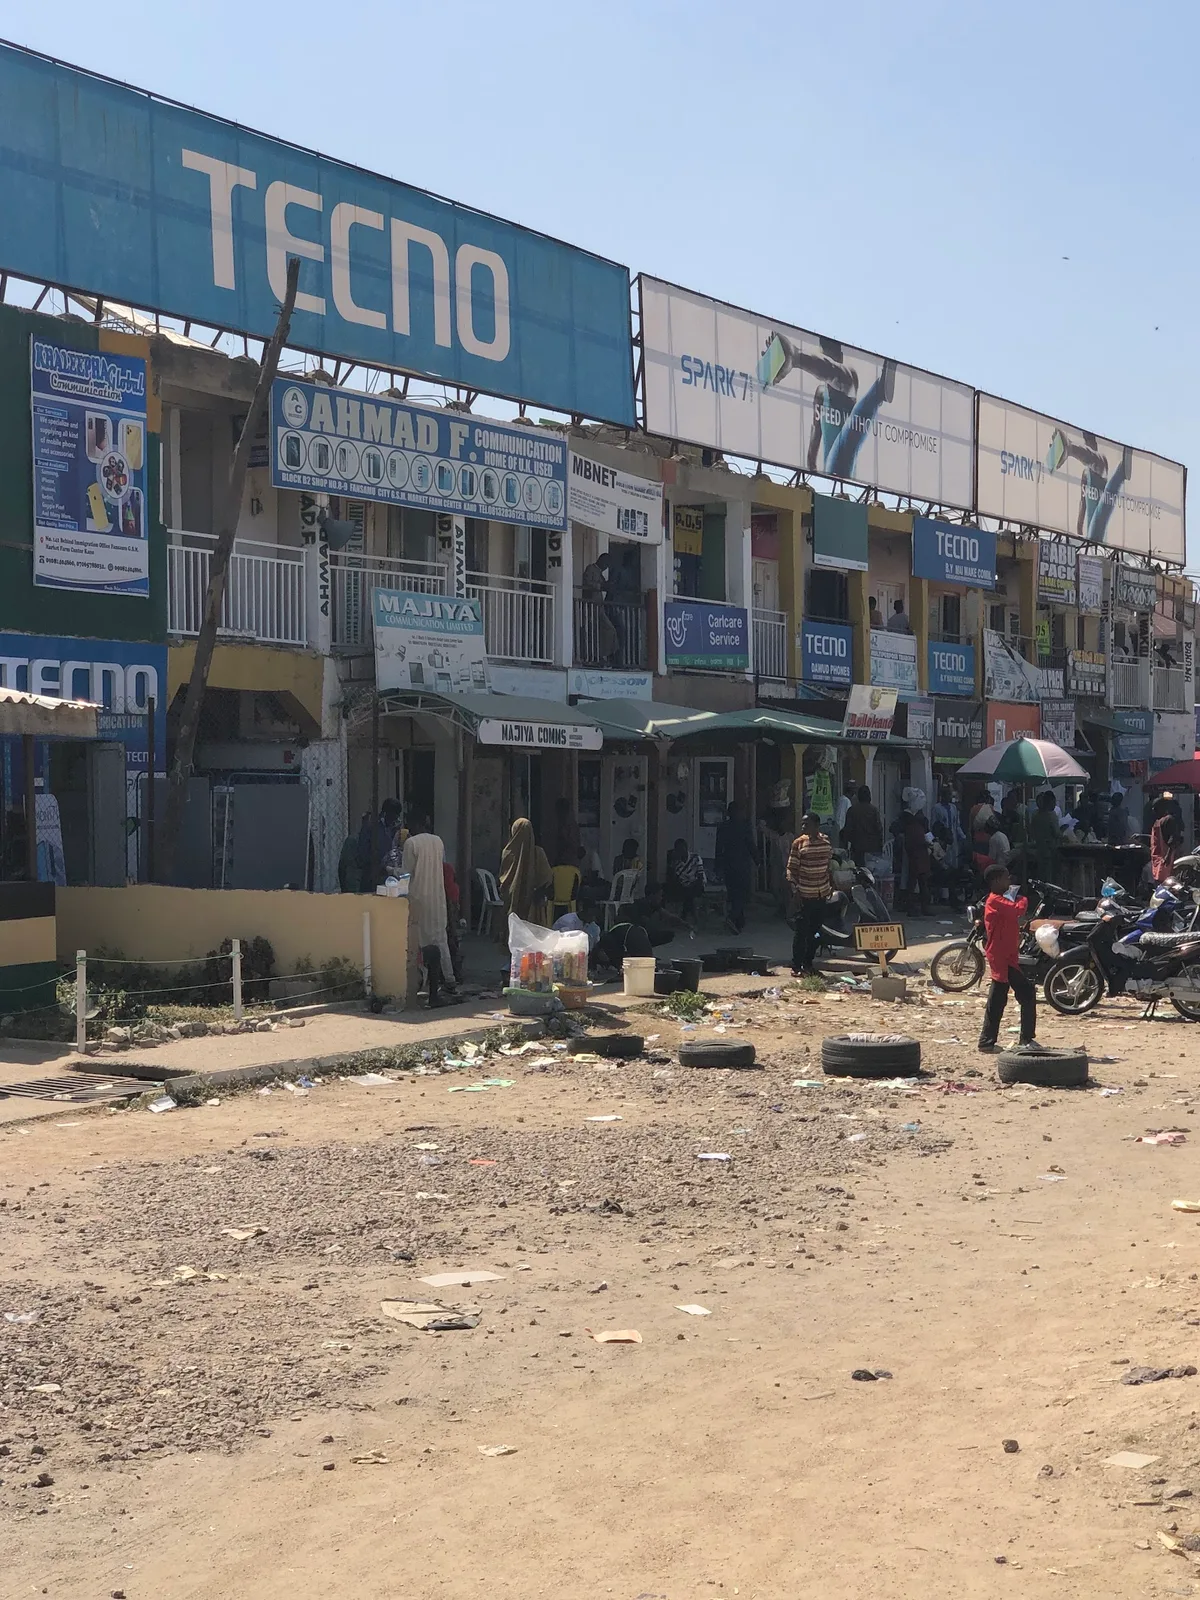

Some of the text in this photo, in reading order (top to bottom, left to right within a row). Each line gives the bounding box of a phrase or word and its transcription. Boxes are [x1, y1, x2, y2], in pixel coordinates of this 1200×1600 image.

[182, 149, 510, 362] TECNO
[50, 373, 122, 403] Communication
[108, 364, 144, 396] Global
[681, 355, 736, 398] SPARK
[740, 372, 748, 401] 7
[40, 428, 62, 437] supplying
[310, 392, 477, 462] AHMAD F.
[815, 404, 937, 453] SPEED WITHOUT COMPROMISE
[46, 438, 61, 446] mobile
[62, 440, 76, 448] phone
[475, 428, 562, 464] COMMUNICATION
[484, 450, 507, 469] HOME
[507, 456, 518, 471] OF
[534, 461, 553, 478] USED
[573, 455, 617, 489] MBNET
[1000, 450, 1034, 482] SPARK
[1035, 460, 1041, 484] 7
[282, 473, 302, 484] BLOCK
[312, 478, 327, 488] SHOP
[378, 488, 391, 497] CITY
[407, 493, 429, 505] MARKET
[444, 498, 462, 510] CENTER
[1081, 484, 1161, 520] SPEED WITHOUT COMPROMISE
[935, 531, 979, 562] TECNO
[1050, 542, 1076, 567] ABU
[1040, 562, 1076, 581] PACK
[379, 594, 480, 622] MAJIYA
[708, 614, 742, 629] Carlcare
[385, 614, 474, 631] COMMUNICATION LIMITED
[710, 632, 740, 645] Service
[805, 633, 847, 658] TECNO
[933, 651, 966, 672] TECNO
[501, 724, 535, 743] MAJIYA
[936, 716, 970, 738] Infinix
[126, 751, 156, 763] TECN
